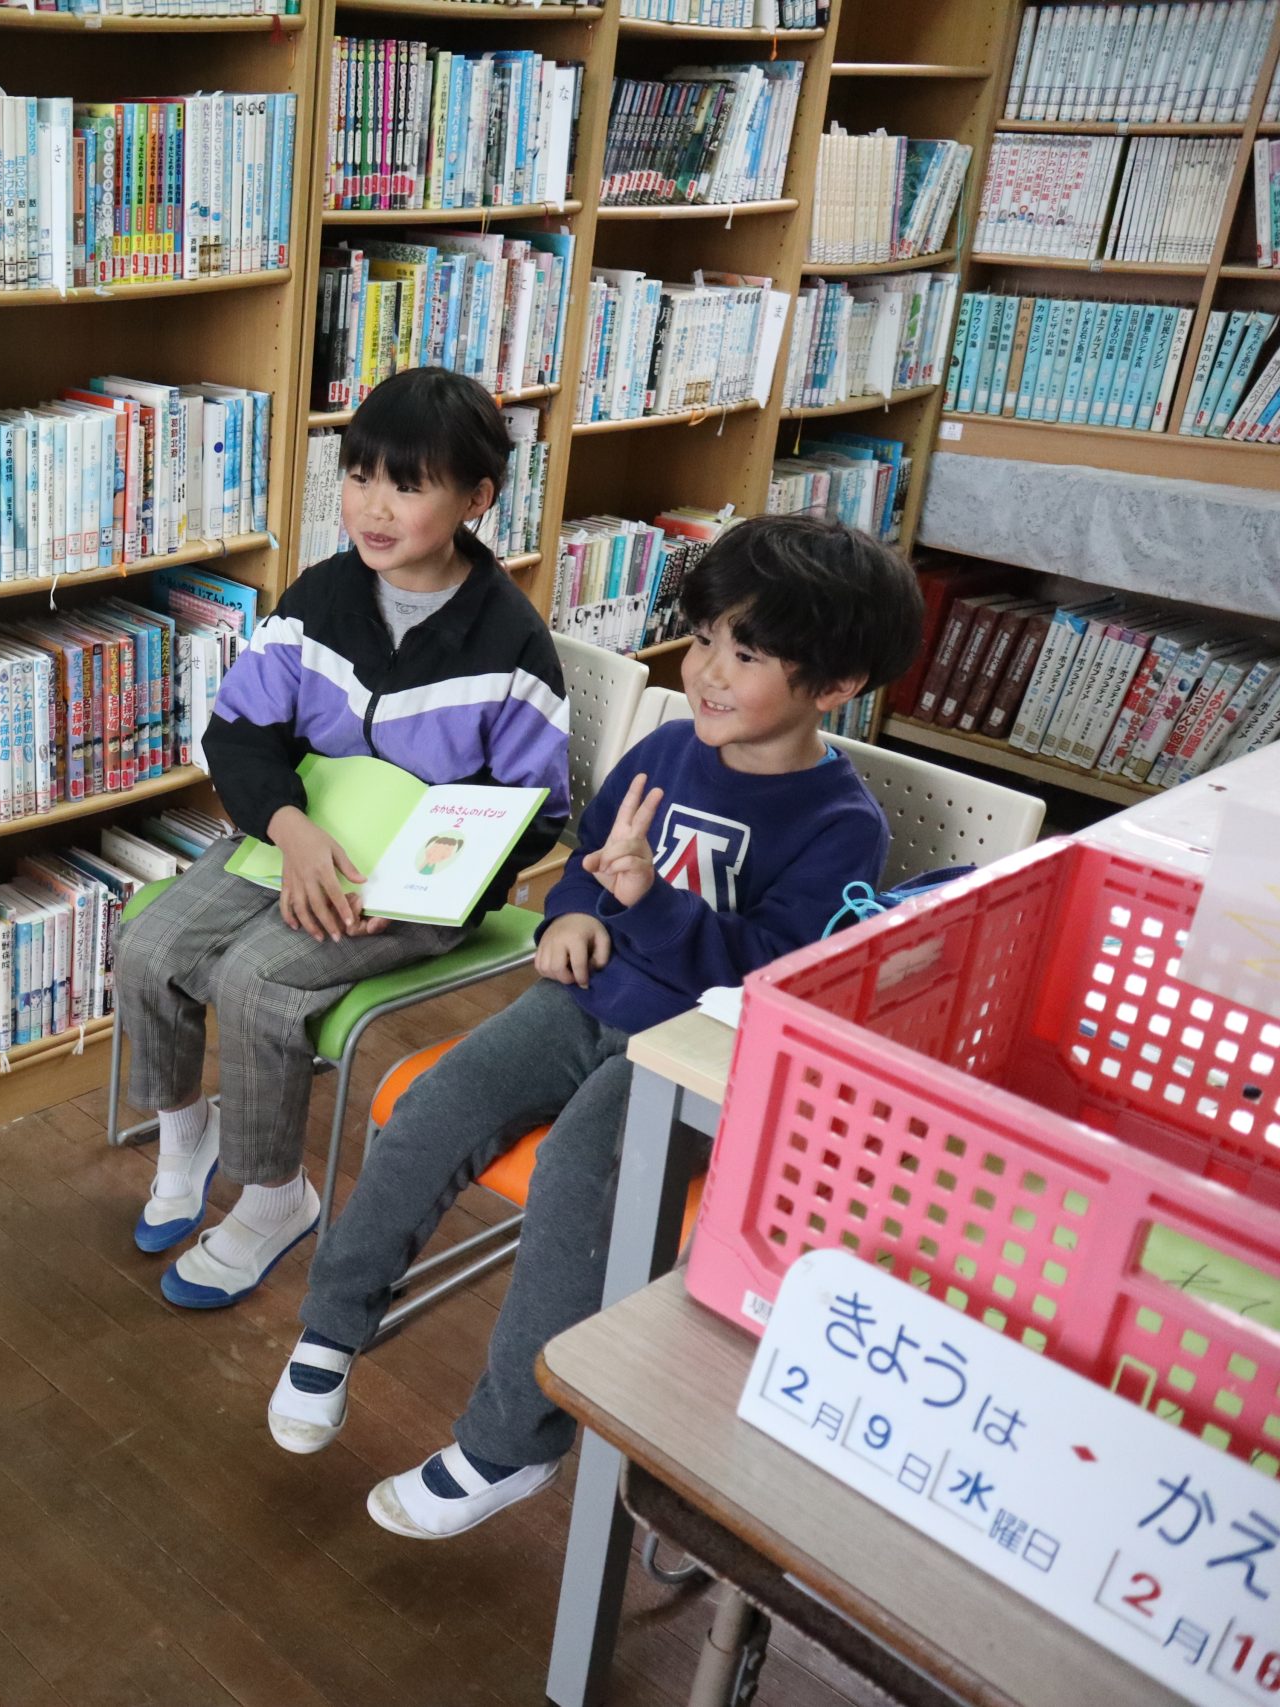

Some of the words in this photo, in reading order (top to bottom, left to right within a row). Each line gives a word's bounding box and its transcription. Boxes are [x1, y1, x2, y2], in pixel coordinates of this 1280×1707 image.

[956, 299, 969, 346] 月の輪グマ
[969, 301, 984, 348] カワウソの海
[988, 302, 1002, 350] ネズミ島物語
[1216, 316, 1241, 369] マヤの一生
[1033, 647, 1054, 686] ポプラディア
[1047, 655, 1068, 695] ポプラディア
[1065, 658, 1086, 697] ポプラディア
[1081, 662, 1102, 700] ポプラディア
[1095, 666, 1116, 705] ポプラディア
[1106, 670, 1128, 709] ポプラディア
[1238, 701, 1268, 739] ポプラディア
[181, 747, 187, 762] 9
[109, 773, 114, 788] 9
[123, 771, 128, 786] 9
[430, 805, 507, 818] おかあさんのパンツ
[453, 818, 464, 828] 2
[824, 1292, 1028, 1453] きょうは
